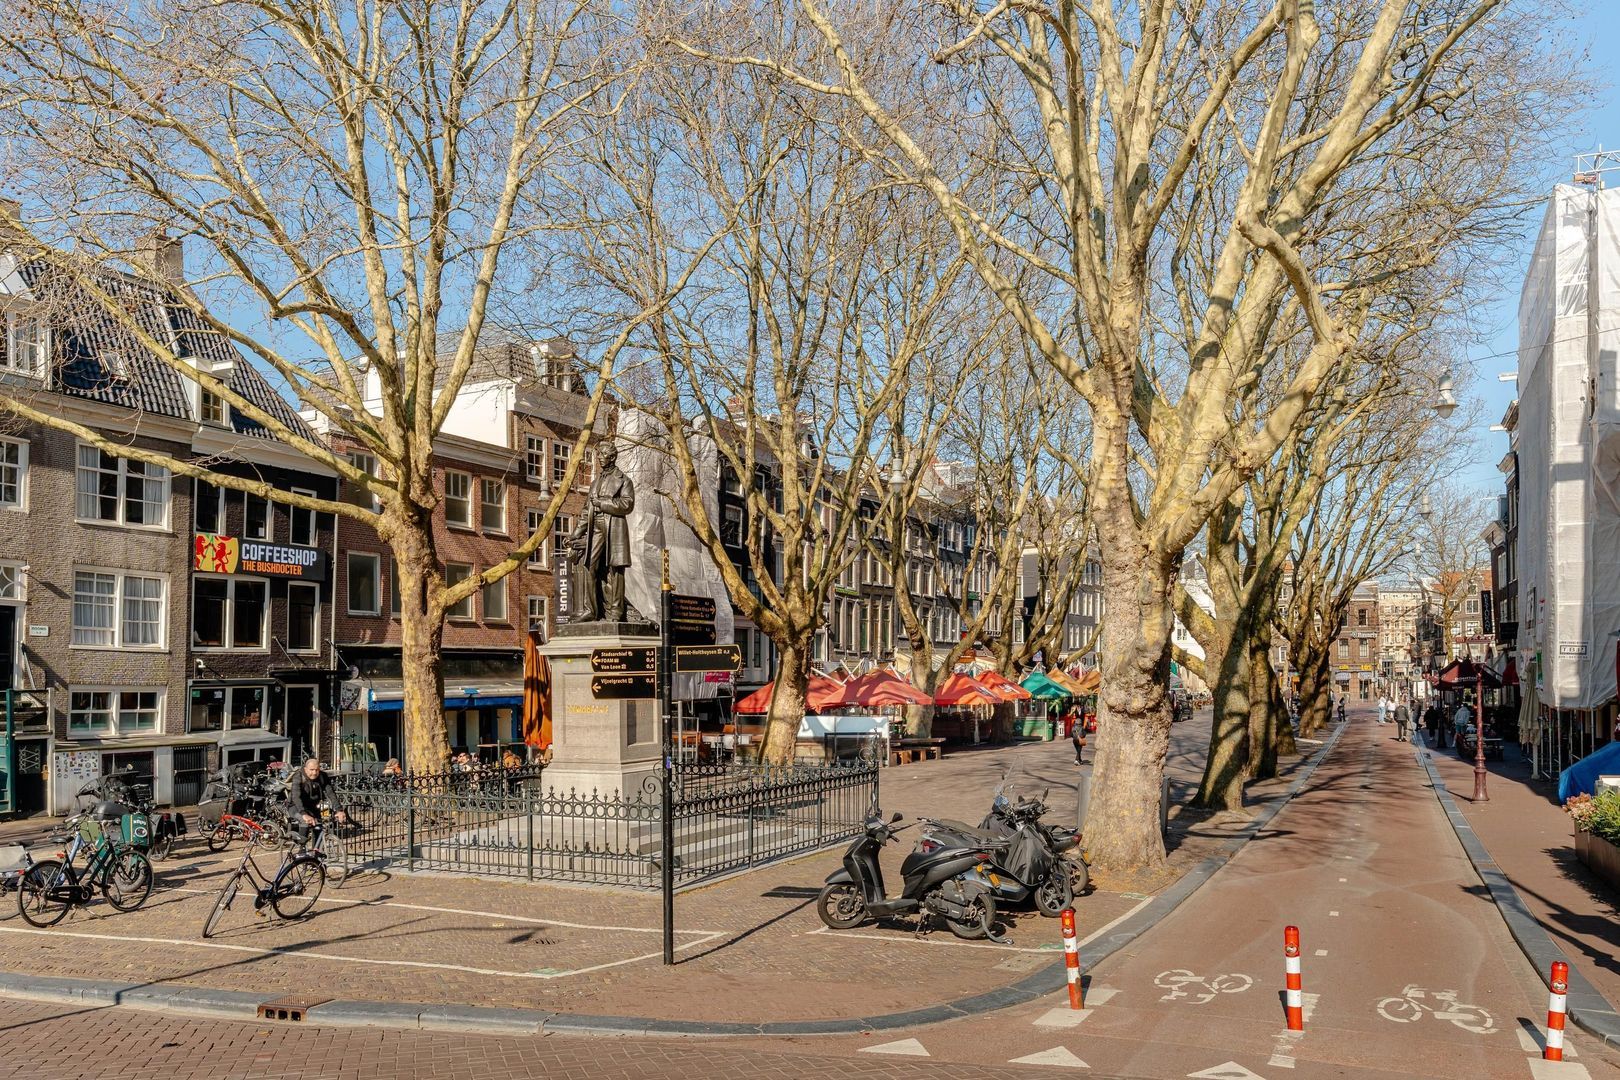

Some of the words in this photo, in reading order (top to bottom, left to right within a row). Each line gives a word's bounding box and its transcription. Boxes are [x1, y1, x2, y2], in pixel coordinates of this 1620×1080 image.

[242, 543, 317, 566] COFFEESHOP
[242, 560, 256, 572] THE
[256, 561, 302, 575] BUSHDOCTER
[559, 560, 567, 576] TE
[559, 579, 568, 612] HUUR
